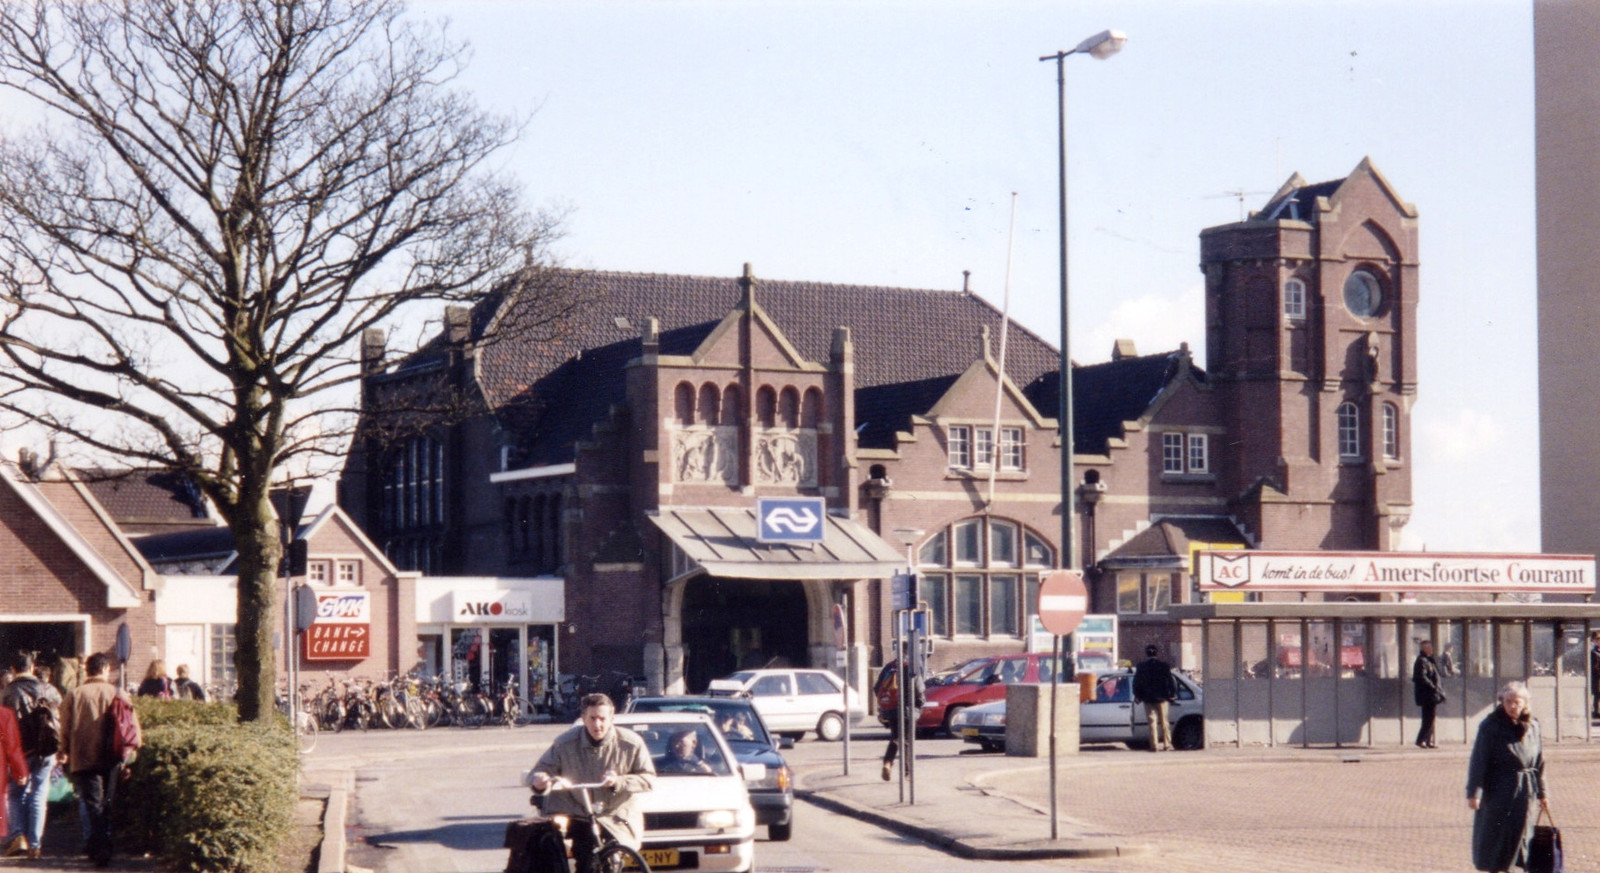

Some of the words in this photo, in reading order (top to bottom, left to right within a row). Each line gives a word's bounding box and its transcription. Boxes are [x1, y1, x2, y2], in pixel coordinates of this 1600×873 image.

[1218, 565, 1243, 579] AC
[1261, 562, 1293, 579] komt
[1294, 566, 1306, 579] in
[1308, 564, 1322, 580] de
[1324, 563, 1355, 580] bus!
[1364, 560, 1501, 583] Amersfoortse
[1506, 562, 1585, 584] Courant
[317, 596, 365, 617] GWK
[460, 602, 503, 615] AKO
[313, 626, 351, 639] BANK
[313, 640, 365, 653] CHANGE
